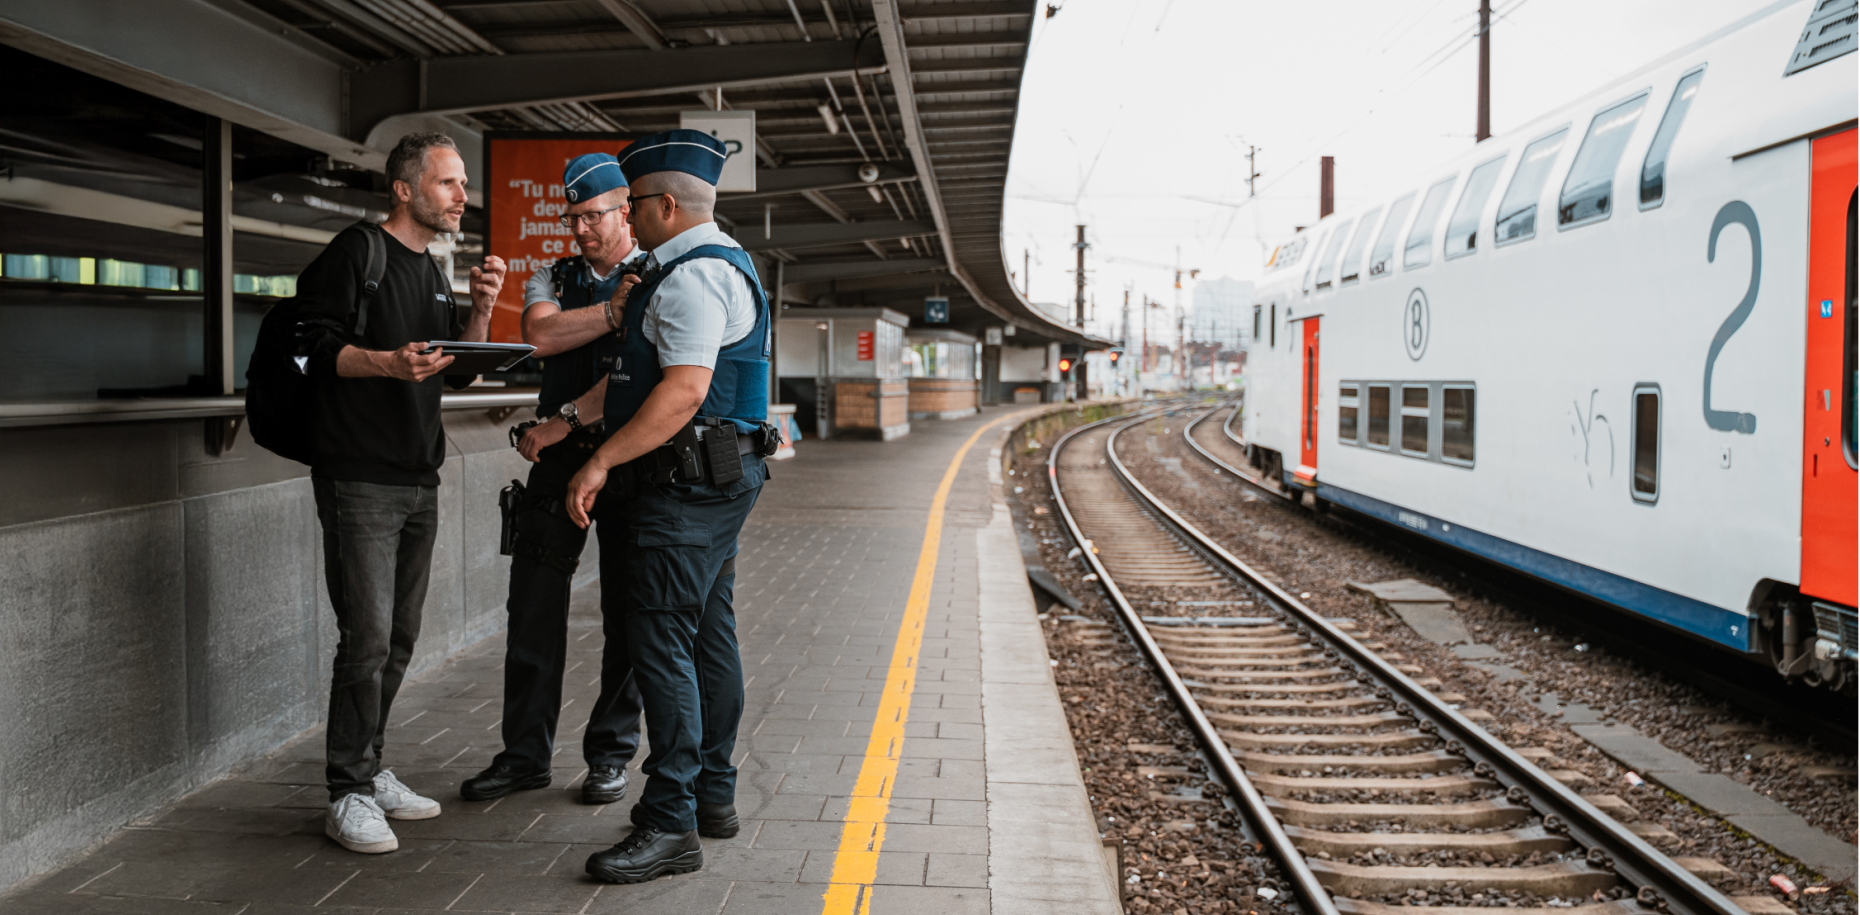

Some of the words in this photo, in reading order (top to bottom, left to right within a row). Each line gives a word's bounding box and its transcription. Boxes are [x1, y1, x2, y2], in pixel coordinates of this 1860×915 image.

[533, 199, 567, 217] dev
[542, 239, 565, 254] ce
[1411, 299, 1423, 350] B
[1703, 200, 1762, 435] 2
